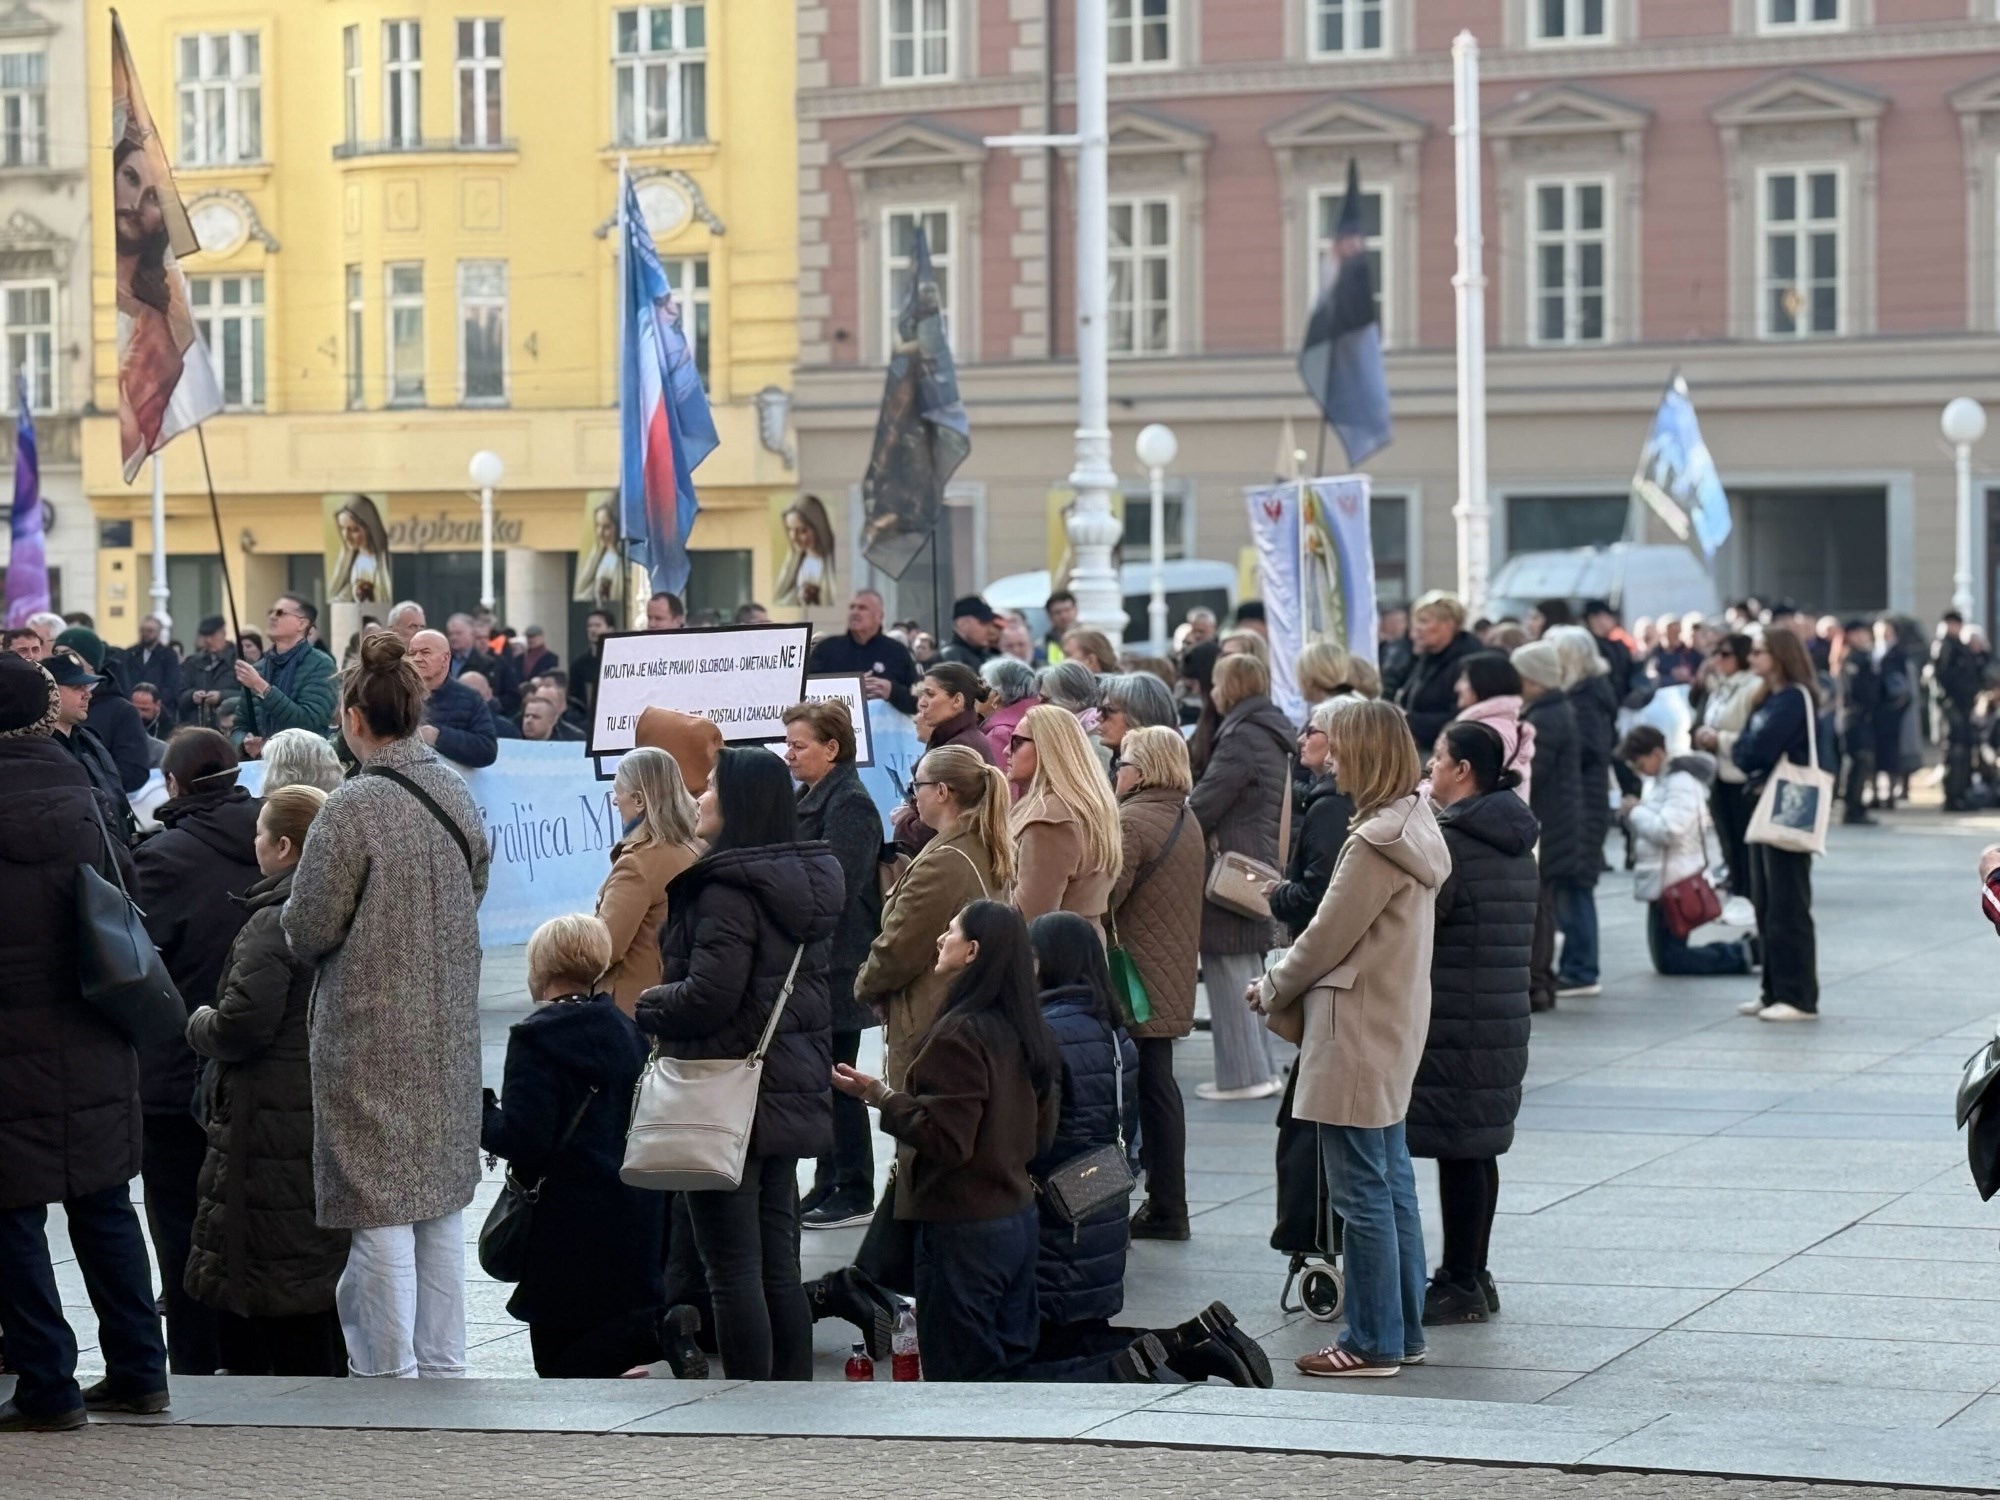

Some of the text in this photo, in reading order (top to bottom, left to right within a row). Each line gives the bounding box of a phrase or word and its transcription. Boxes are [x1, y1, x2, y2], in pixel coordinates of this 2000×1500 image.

[603, 662, 635, 679] MOLITVA
[636, 662, 648, 677] JE
[647, 657, 668, 677] NAŠE
[668, 658, 694, 675] PRAVO
[699, 657, 734, 674] SLOBODA
[739, 654, 779, 671] OMETANJE
[607, 716, 616, 731] TU
[617, 714, 628, 730] JE
[479, 802, 574, 882] raljica
